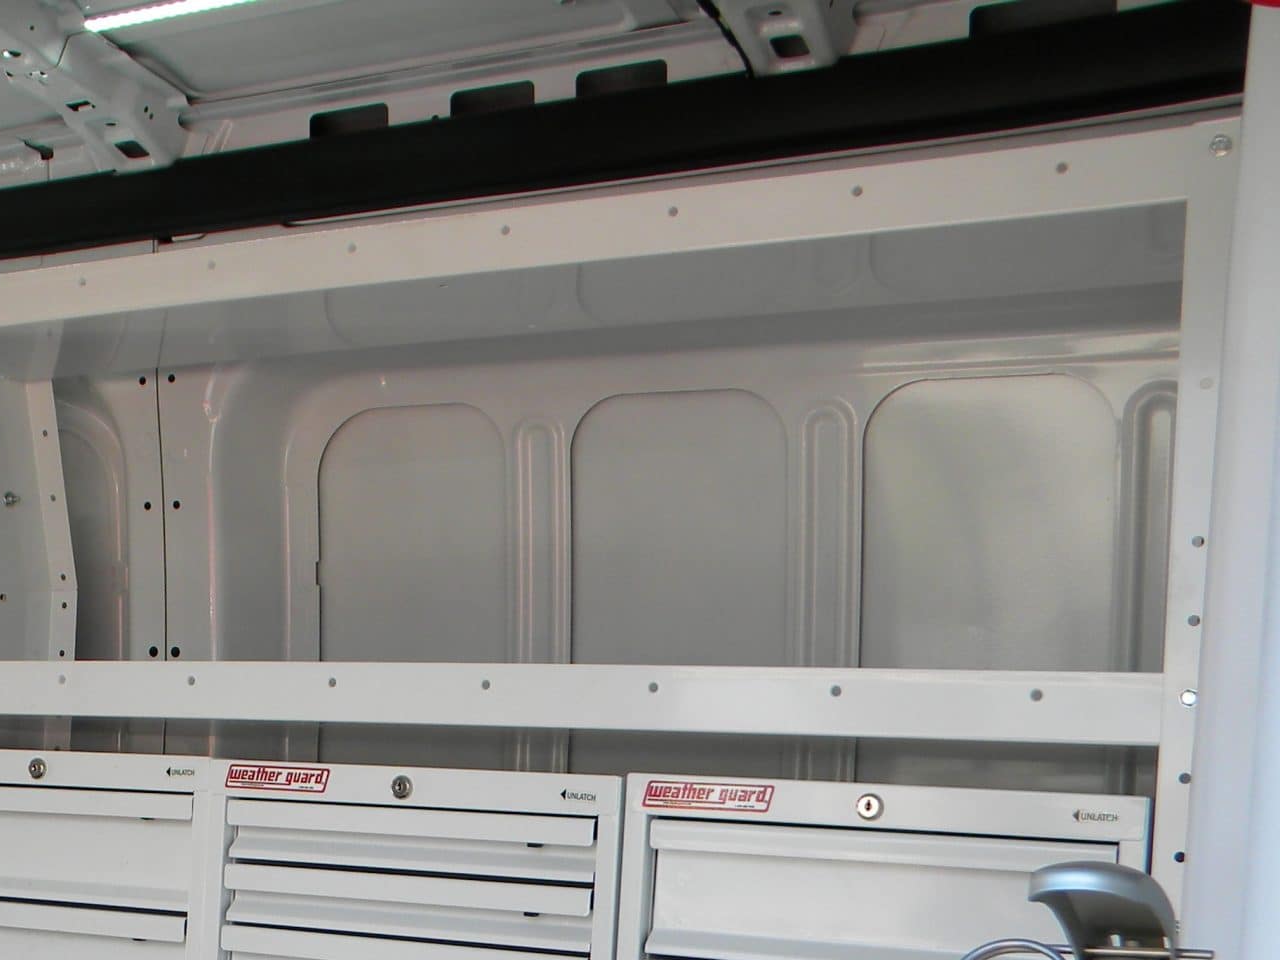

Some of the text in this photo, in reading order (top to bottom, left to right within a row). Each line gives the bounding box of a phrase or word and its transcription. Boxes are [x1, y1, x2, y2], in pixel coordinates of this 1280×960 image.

[229, 767, 323, 787] weather guard
[566, 791, 597, 801] UNLATCH
[647, 782, 768, 804] weather guard
[1081, 812, 1118, 822] UNLATCH
